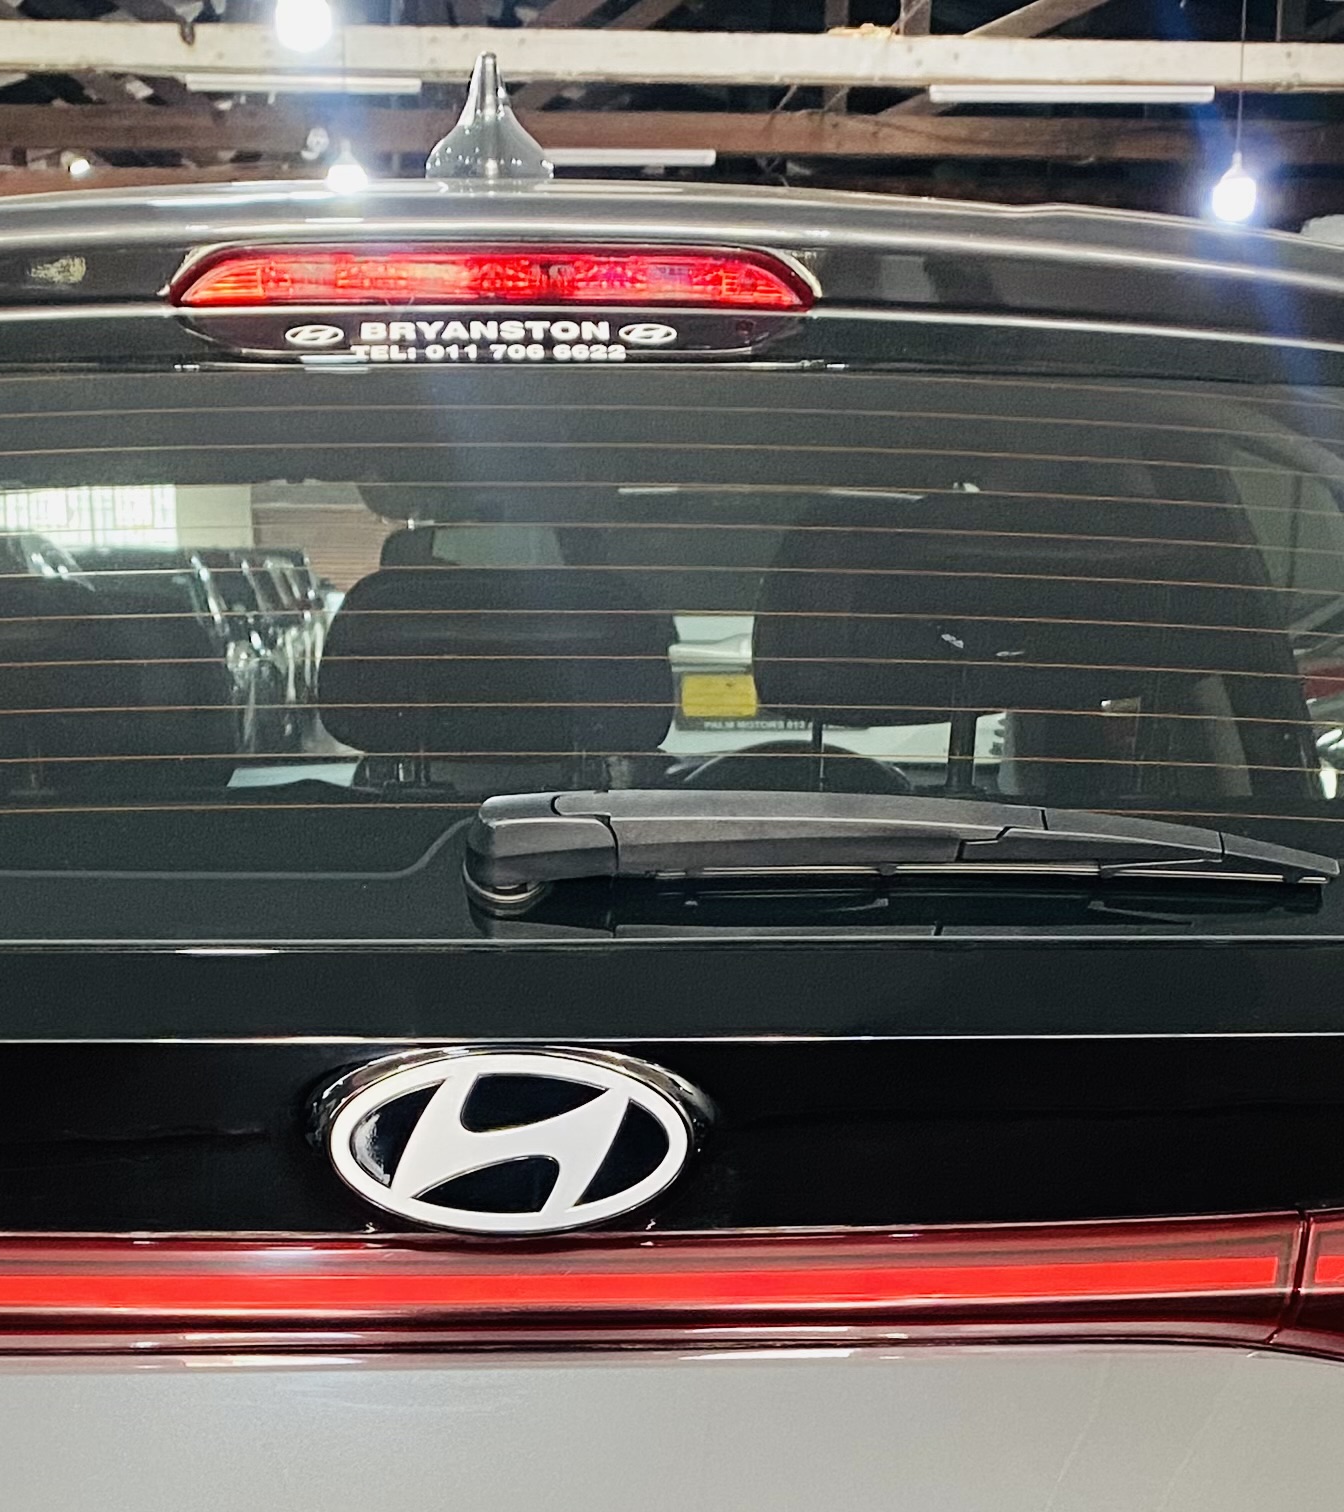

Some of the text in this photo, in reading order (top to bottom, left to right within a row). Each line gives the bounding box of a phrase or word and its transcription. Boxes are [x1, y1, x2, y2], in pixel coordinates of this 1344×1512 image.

[360, 321, 610, 341] BRYANSTON
[351, 344, 416, 360] TEL:
[425, 344, 477, 361] 011
[489, 344, 544, 361] 706
